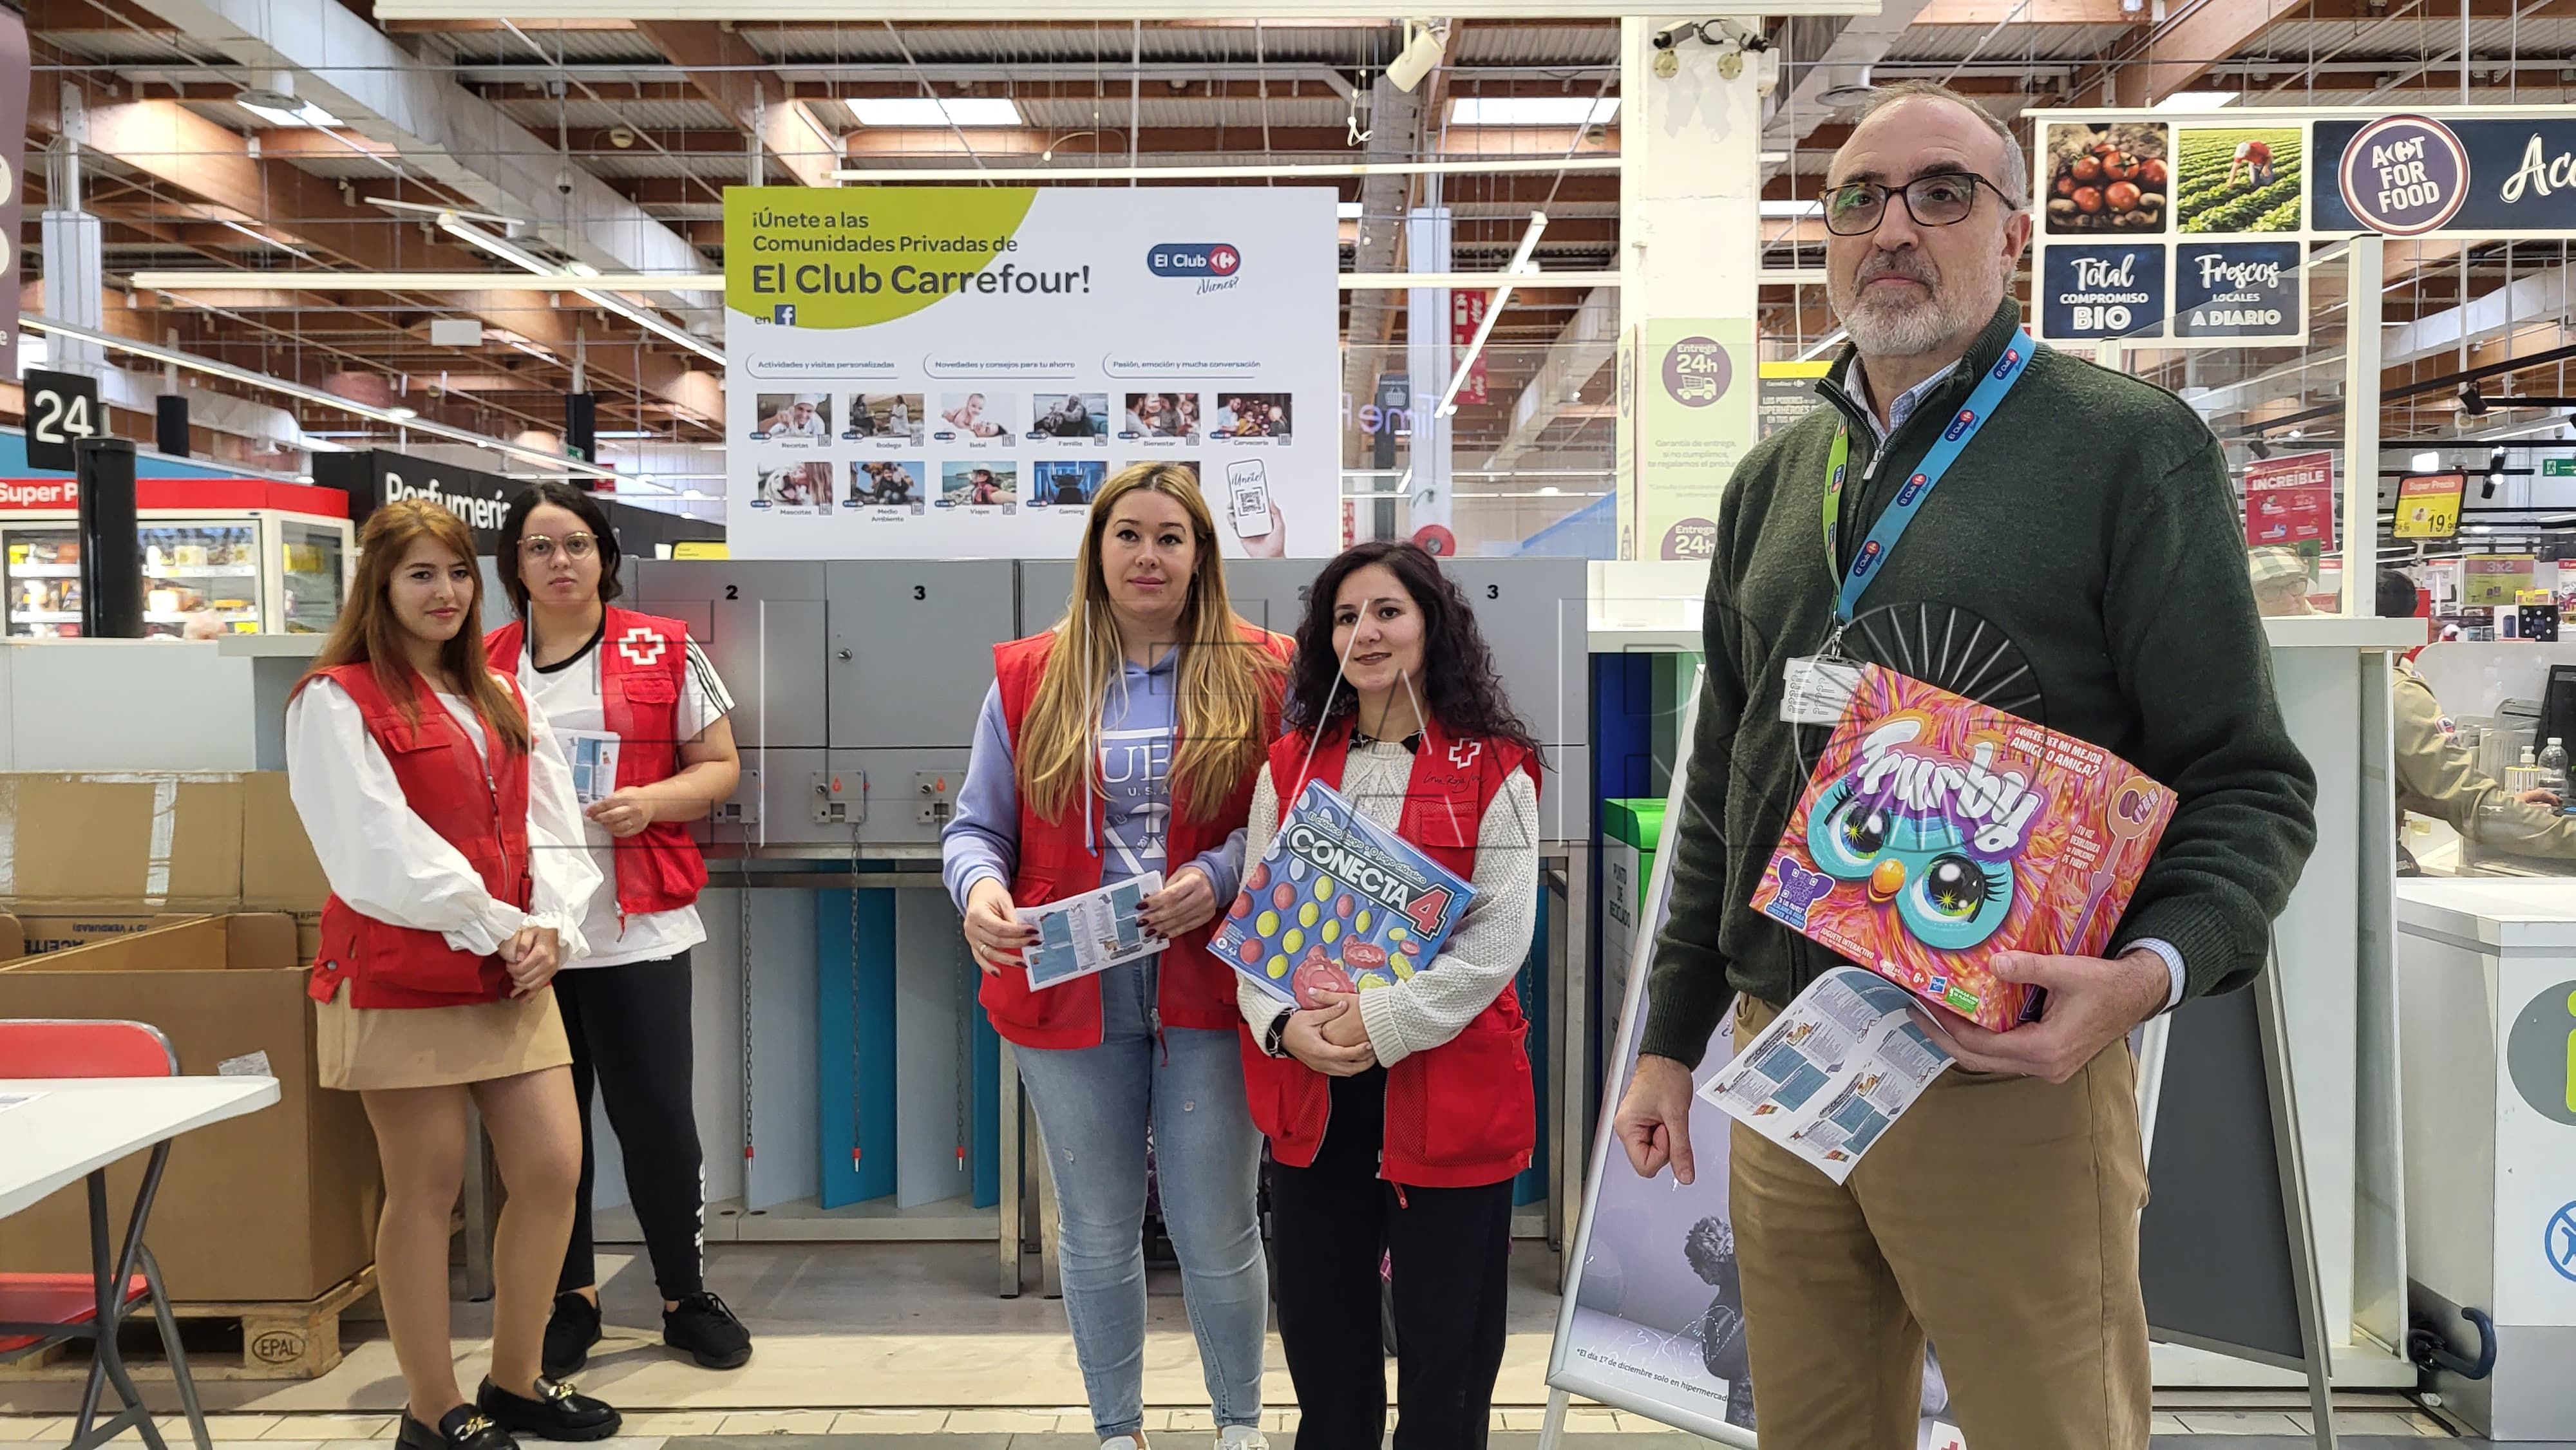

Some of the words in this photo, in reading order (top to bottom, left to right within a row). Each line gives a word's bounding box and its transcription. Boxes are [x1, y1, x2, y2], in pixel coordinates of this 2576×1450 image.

[2380, 161, 2428, 190] FOR
[2378, 181, 2440, 213] FOOD
[824, 214, 836, 227] a
[841, 212, 869, 227] las
[753, 236, 895, 252] Comunidades
[900, 236, 988, 252] Privadas
[992, 236, 1018, 252] de
[1153, 254, 1168, 267] El
[1173, 254, 1207, 267] Club
[753, 263, 786, 293] El
[796, 264, 882, 293] Club
[891, 264, 1090, 293] Carrefour!
[2070, 253, 2136, 291] Total
[2194, 254, 2280, 289] Frescos
[2060, 292, 2149, 305] COMPROMISO
[2212, 293, 2260, 303] LOCALES
[754, 314, 771, 325] en
[2072, 306, 2132, 331] BIO
[2191, 310, 2207, 326] A
[2210, 309, 2282, 326] DIARIO
[1676, 344, 1718, 354] Entrega
[837, 361, 895, 370] personalizadas
[985, 361, 1019, 370] consejos
[1676, 354, 1718, 373] 24h
[34, 388, 95, 444] 24
[2252, 470, 2325, 491] INCREÍBLE
[0, 482, 62, 507] Super
[1676, 525, 1715, 535] Entrega
[726, 585, 738, 599] 2
[914, 585, 926, 600] 3
[1487, 584, 1499, 600] 3
[2010, 737, 2045, 758] AMIGO
[2046, 751, 2053, 761] O
[2054, 754, 2100, 778] AMIGA?
[2046, 736, 2059, 748] SER
[2059, 740, 2071, 753] MI
[2072, 744, 2103, 765] MEJOR
[1857, 720, 2040, 852] Furby
[1307, 812, 1317, 822] El
[1316, 815, 1341, 836] clásico
[1341, 829, 1365, 849] juego
[1378, 851, 1396, 868] jogo
[1396, 862, 1427, 885] clássico
[1291, 829, 1412, 912] CONECTA
[1406, 889, 1448, 935] 4
[1820, 926, 1842, 943] JUGUETE
[1841, 937, 1875, 959] INTERACTIVO
[1913, 972, 1925, 984] 6+
[261, 1337, 298, 1356] EPAL
[1587, 1350, 1598, 1361] día
[1599, 1355, 1607, 1363] 17
[1608, 1359, 1617, 1367] de
[1618, 1362, 1653, 1378] diciembre
[1653, 1373, 1669, 1384] solo
[1670, 1379, 1680, 1387] en
[1680, 1381, 1729, 1402] hipermercad
